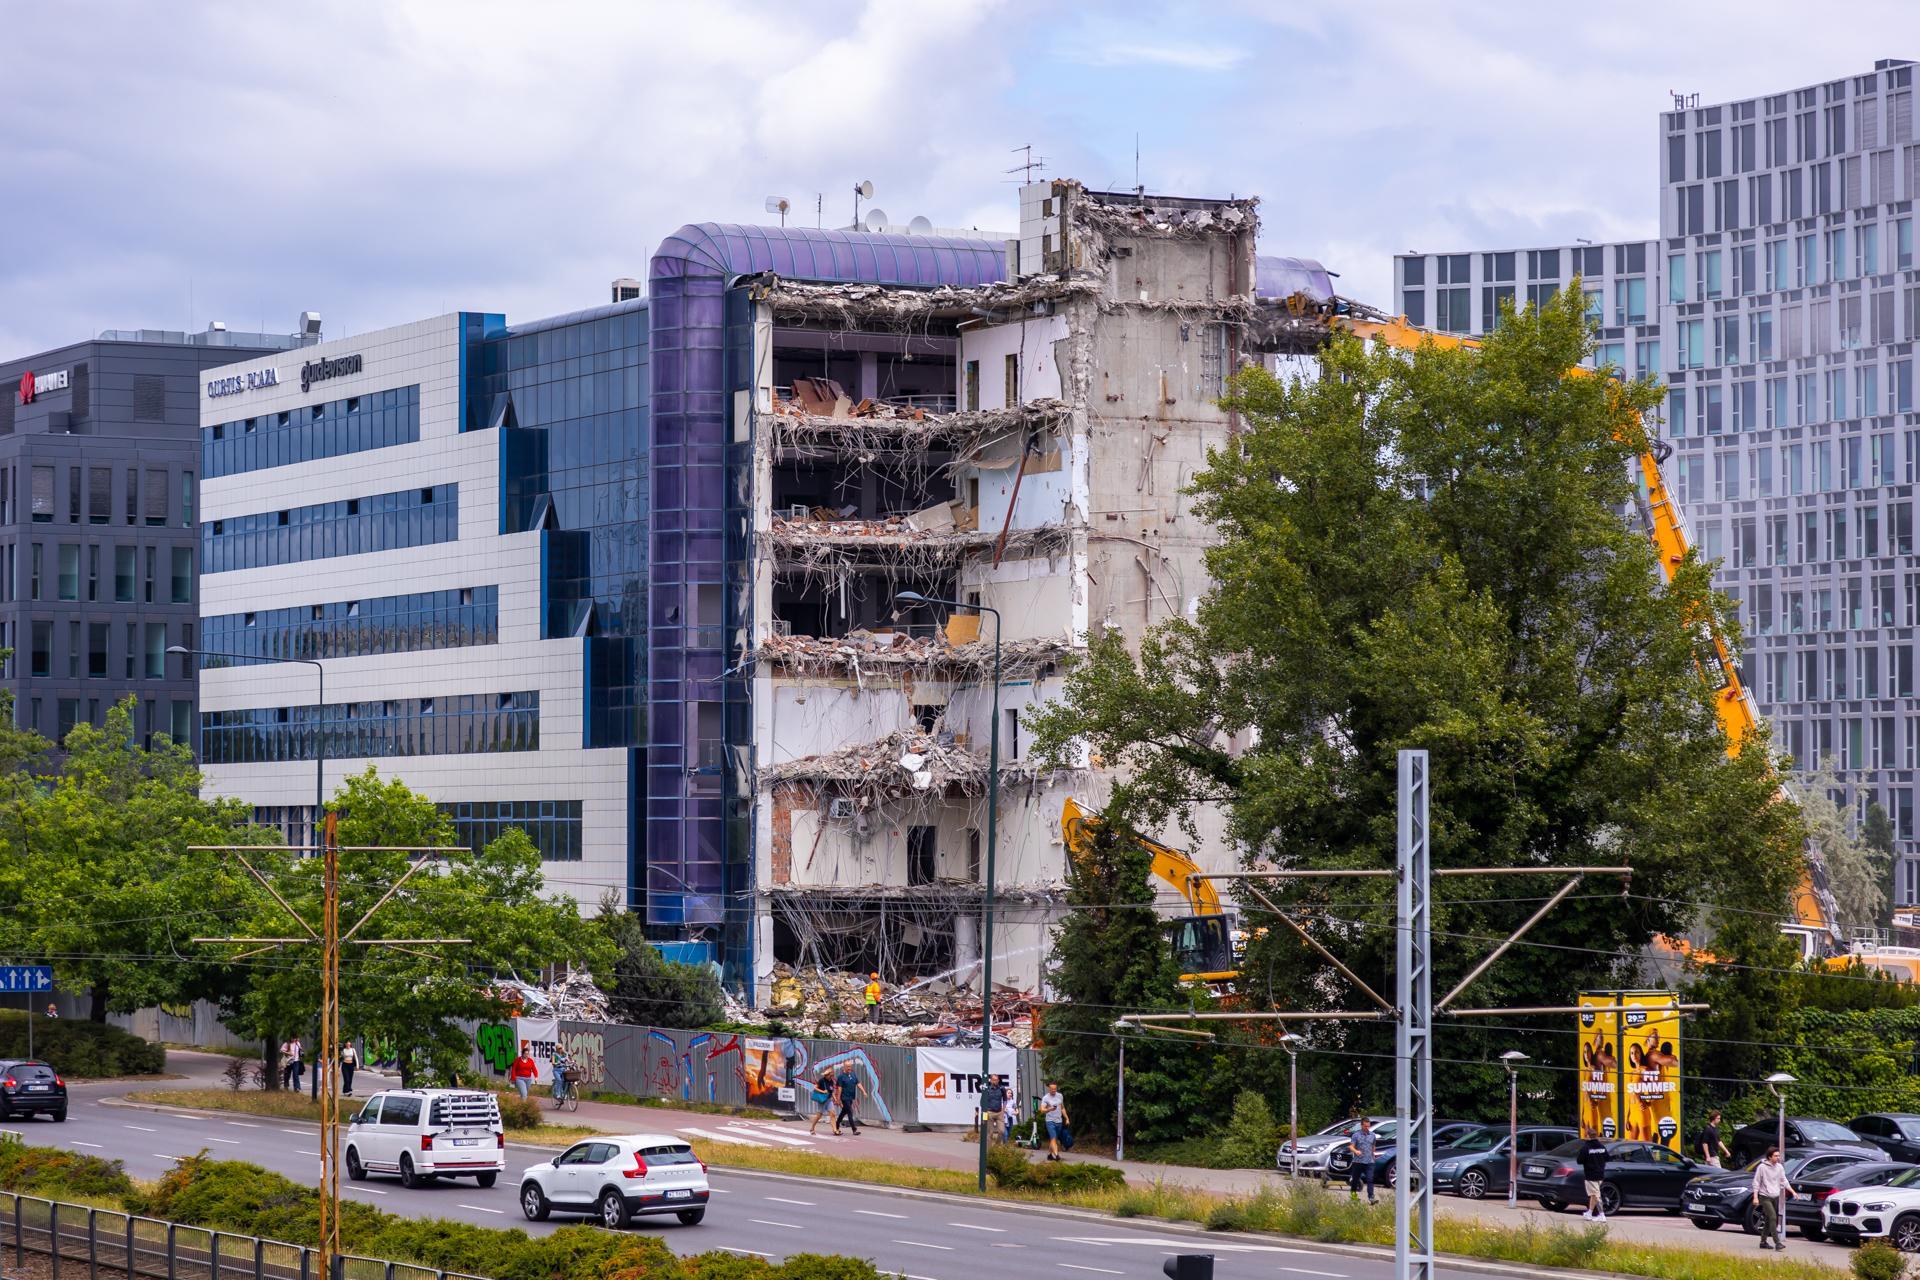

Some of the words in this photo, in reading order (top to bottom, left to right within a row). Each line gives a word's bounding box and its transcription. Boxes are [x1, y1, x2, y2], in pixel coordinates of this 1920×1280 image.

[208, 375, 244, 398] CURTIS
[247, 368, 279, 390] PLAZA
[301, 354, 362, 392] guidevision
[1582, 1081, 1615, 1093] SUMMER
[1627, 1082, 1676, 1093] SUMMER
